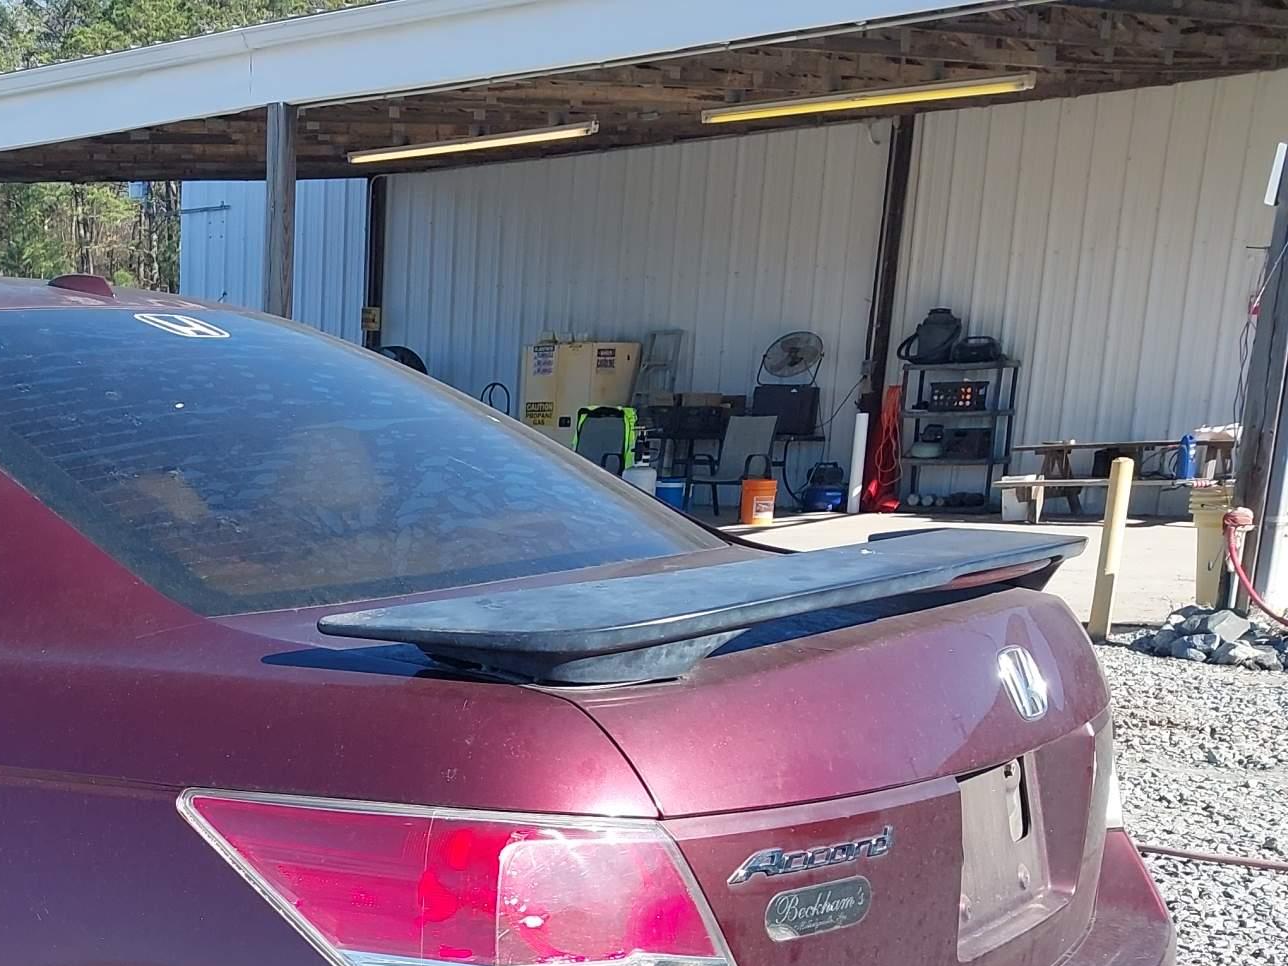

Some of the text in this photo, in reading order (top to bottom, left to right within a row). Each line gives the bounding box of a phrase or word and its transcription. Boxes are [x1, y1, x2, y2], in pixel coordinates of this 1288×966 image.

[527, 403, 553, 412] CAUTION
[727, 825, 893, 884] Accord
[775, 887, 865, 924] Beckham's
